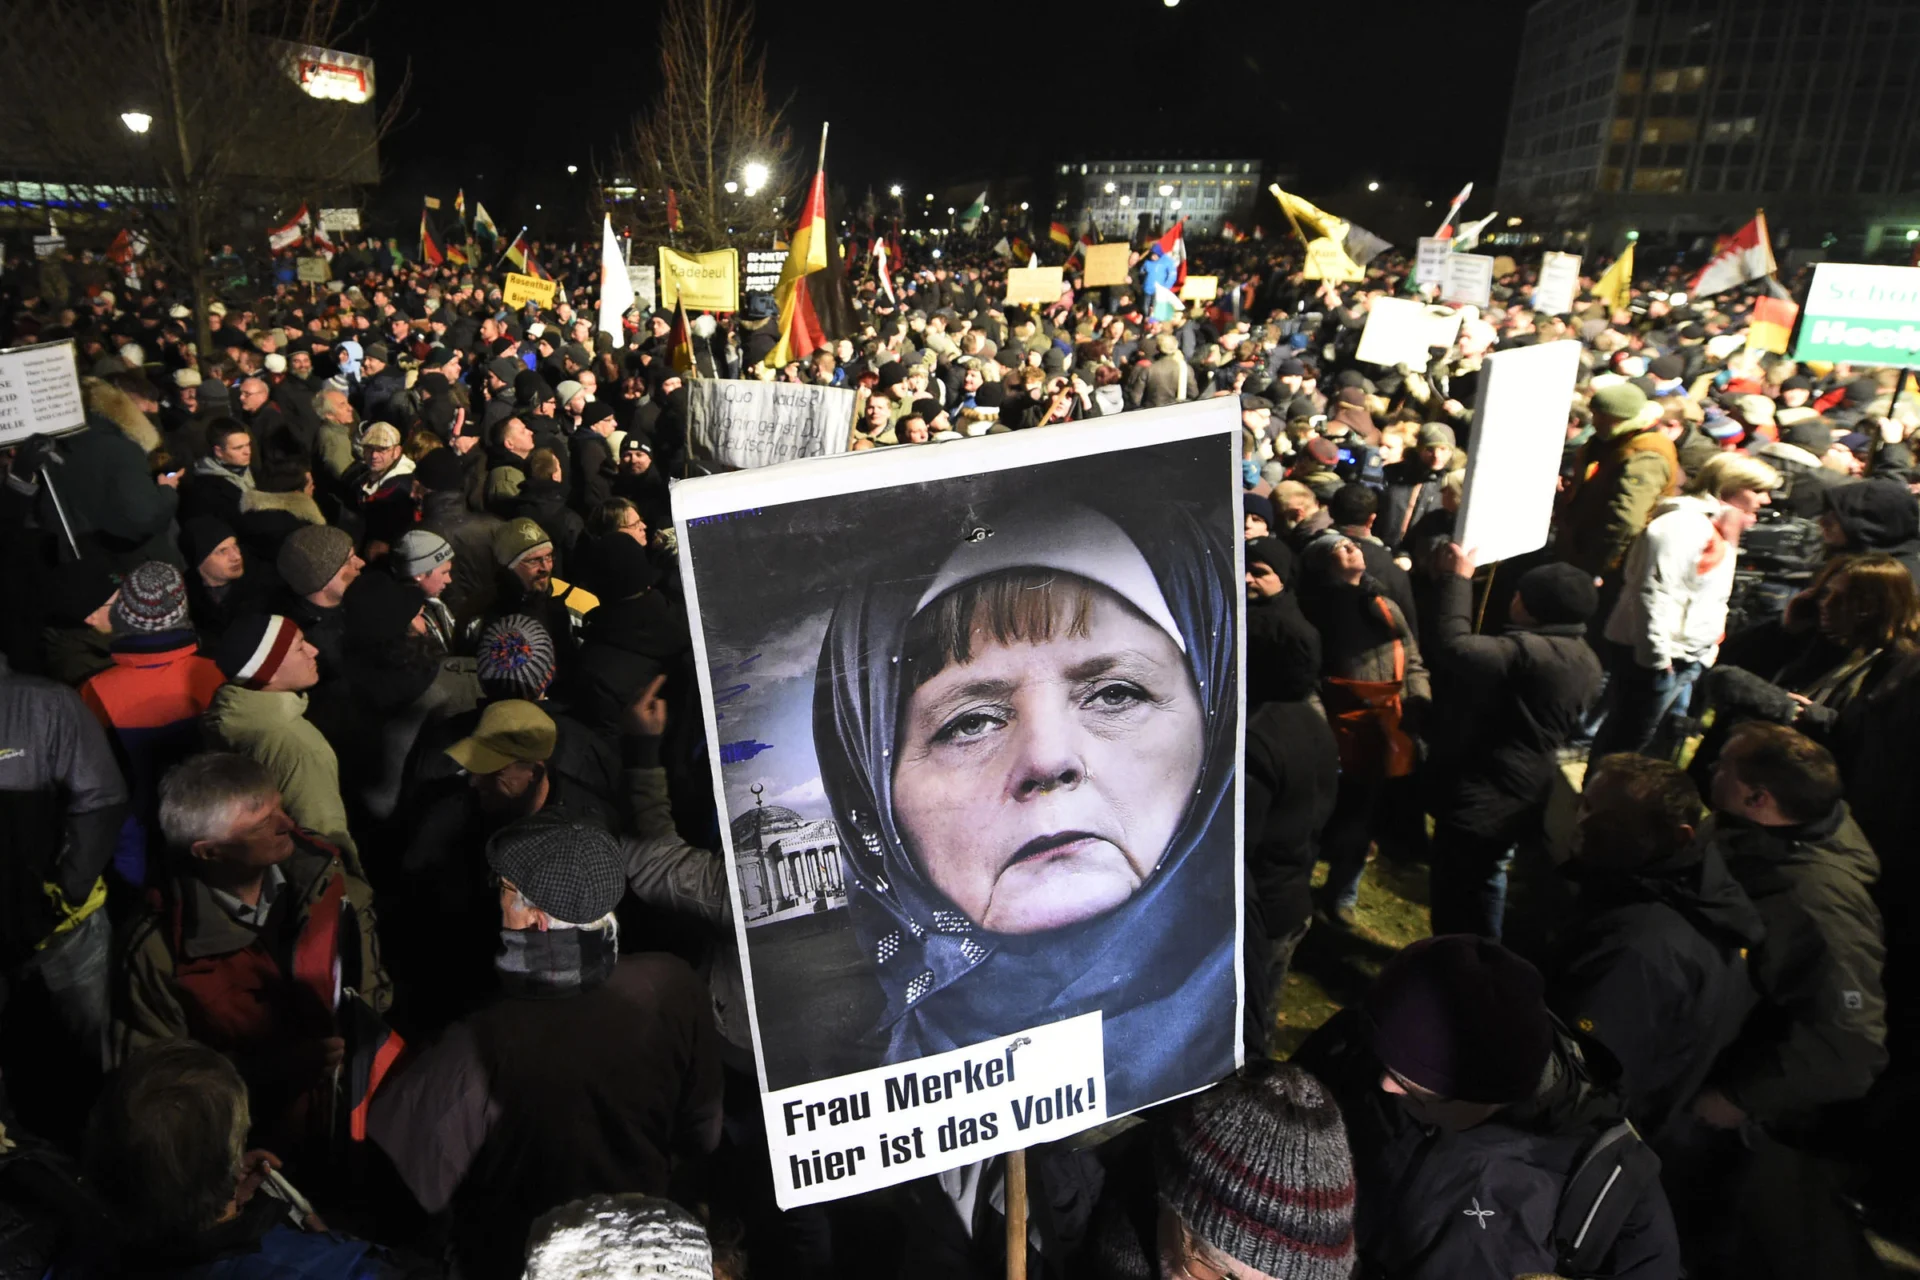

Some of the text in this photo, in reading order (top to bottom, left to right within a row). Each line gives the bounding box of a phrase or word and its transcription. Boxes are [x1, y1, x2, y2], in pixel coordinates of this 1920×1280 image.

[510, 274, 552, 292] Rosenthal
[670, 264, 727, 278] Radebeul
[783, 1048, 1016, 1136] Frau Merkel
[790, 1077, 1097, 1190] hier ist das Volk!
